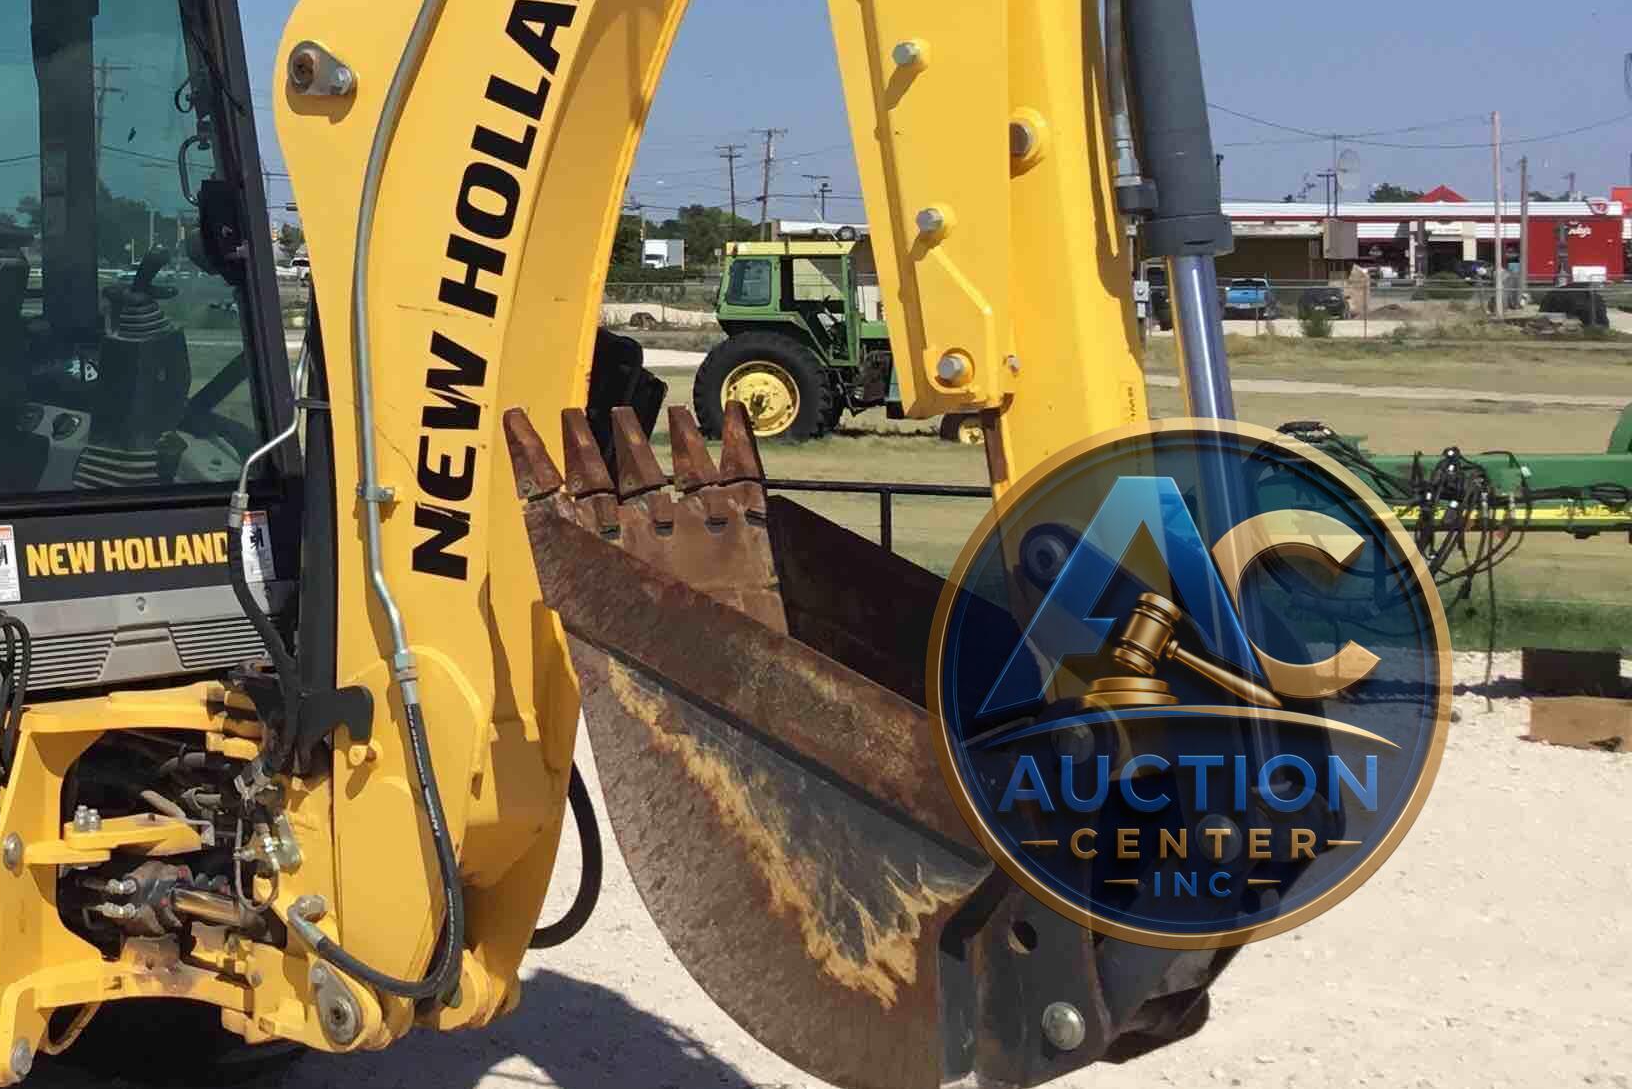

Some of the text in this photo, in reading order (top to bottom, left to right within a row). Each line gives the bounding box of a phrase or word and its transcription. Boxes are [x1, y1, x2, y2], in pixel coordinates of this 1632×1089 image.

[412, 332, 489, 581] NEW
[26, 542, 96, 577] NEW
[102, 531, 228, 572] HOLLAND
